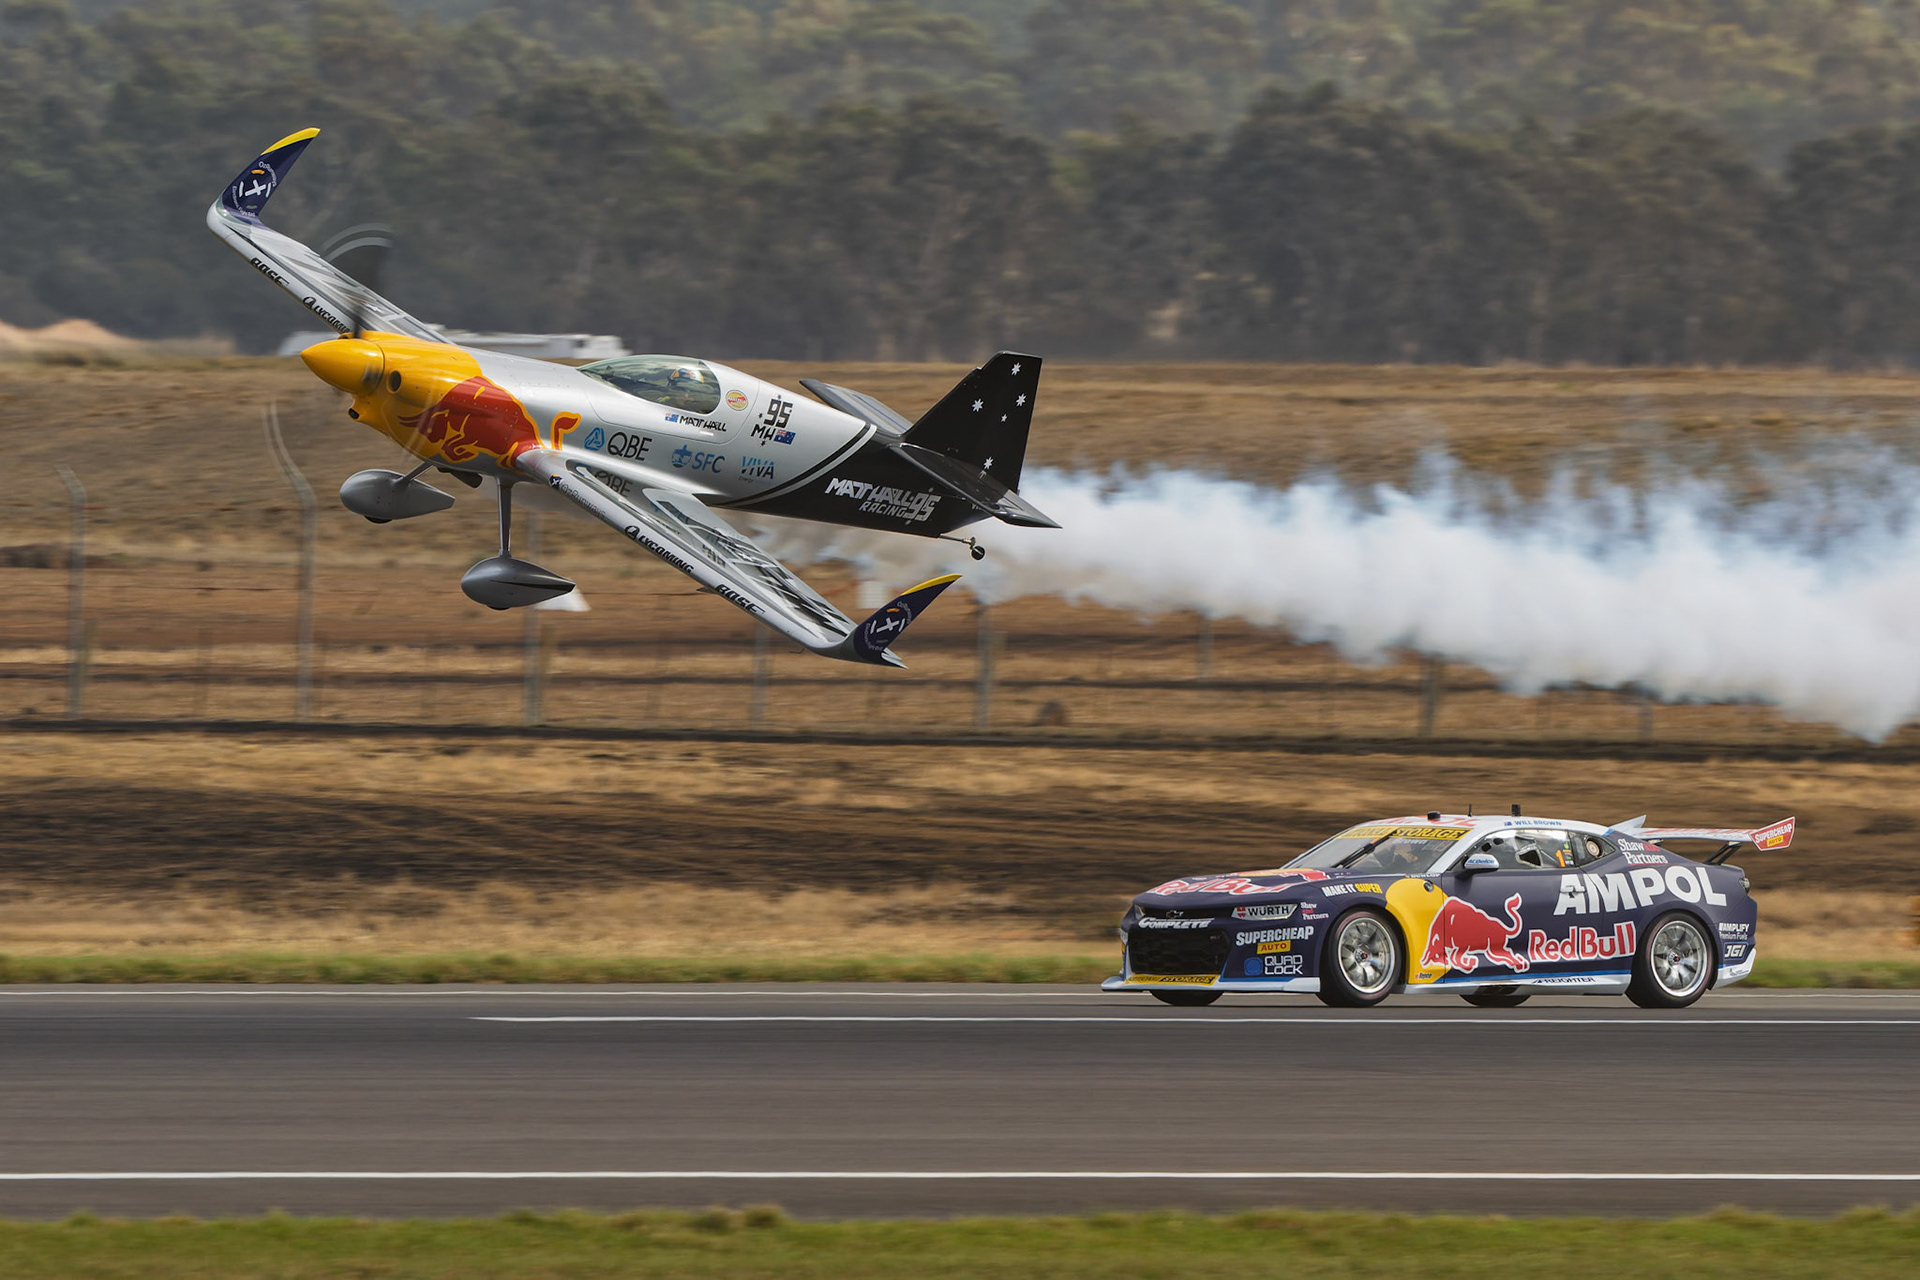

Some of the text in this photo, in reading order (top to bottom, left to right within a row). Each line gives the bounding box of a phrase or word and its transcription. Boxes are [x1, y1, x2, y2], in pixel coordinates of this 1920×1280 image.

[763, 398, 793, 429] 95
[751, 423, 776, 441] MH
[607, 431, 653, 461] QBE
[692, 451, 725, 474] SFC
[740, 455, 775, 480] VIVA
[858, 500, 908, 518] RACING
[638, 535, 695, 575] LYCOMING
[1617, 838, 1645, 851] Shaw
[1622, 852, 1669, 864] Partners
[1321, 884, 1348, 897] MAKE
[1553, 865, 1728, 916] AMPOL
[1247, 904, 1290, 917] WÜRTH
[1236, 926, 1314, 946] SUPERCHEAP
[1260, 942, 1287, 952] AUTO
[1264, 955, 1303, 965] QUAD
[1264, 964, 1303, 975] LOCK
